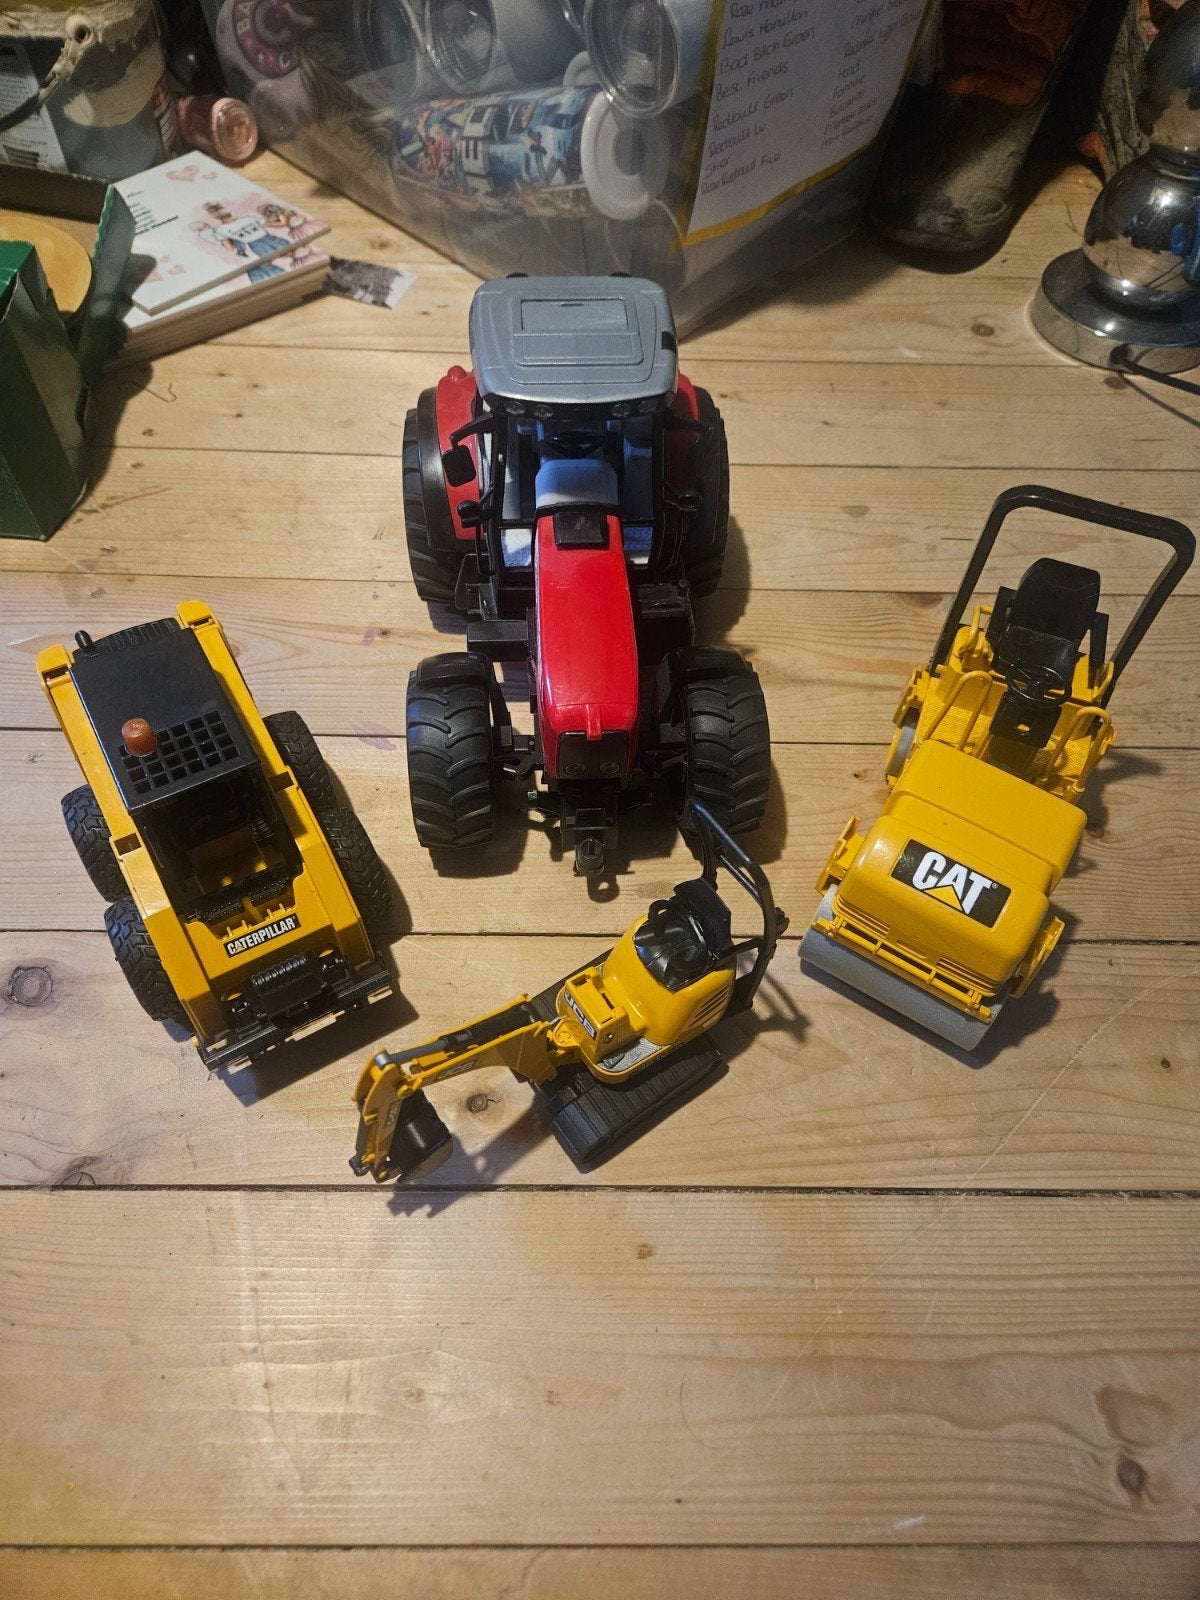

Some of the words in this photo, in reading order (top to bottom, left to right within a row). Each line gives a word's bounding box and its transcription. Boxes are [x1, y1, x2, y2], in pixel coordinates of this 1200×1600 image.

[912, 851, 993, 915] CAT
[226, 915, 296, 955] CATERPILLAR
[564, 993, 596, 1038] JCB
